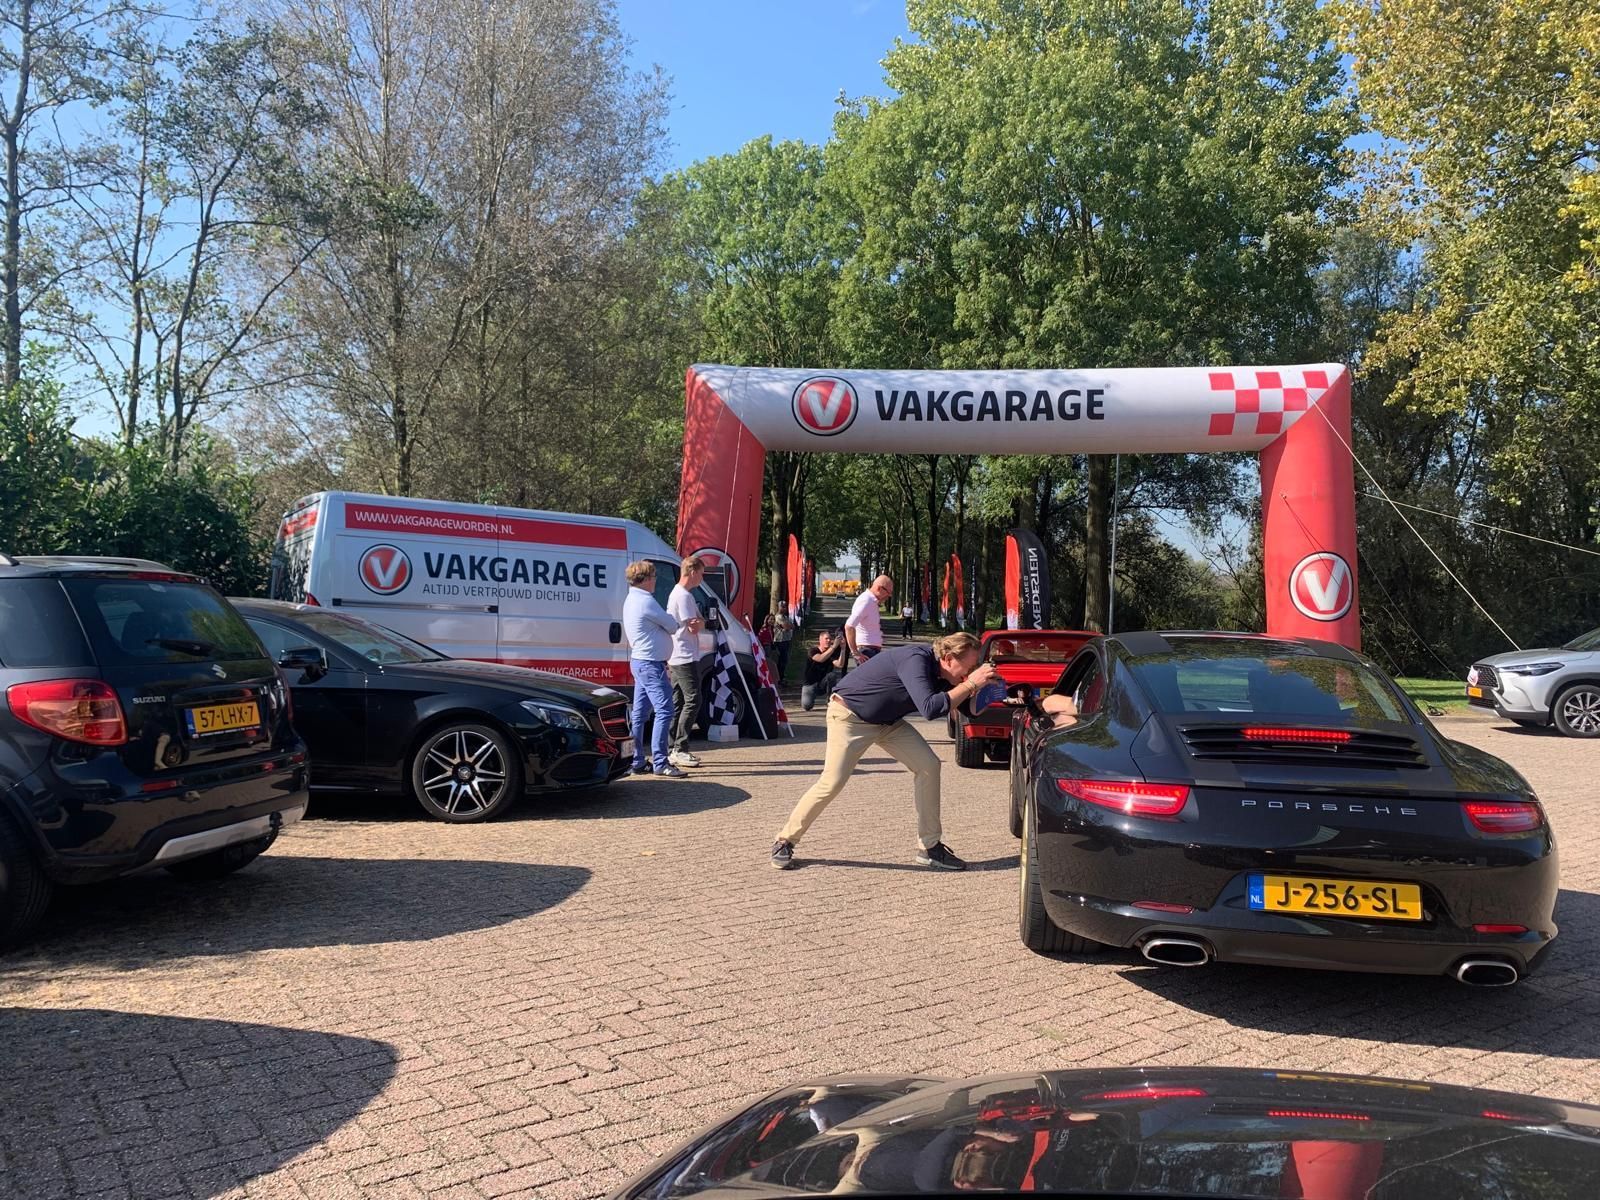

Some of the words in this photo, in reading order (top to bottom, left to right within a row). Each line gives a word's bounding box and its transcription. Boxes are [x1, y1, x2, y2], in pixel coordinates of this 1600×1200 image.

[807, 380, 847, 426] V
[875, 389, 1105, 421] VAKGARAGE
[355, 511, 515, 535] WWW.VAKGARAGEWORDEN.NL
[371, 549, 404, 587] V
[424, 552, 607, 589] VAKGARAGE
[422, 583, 459, 595] ALTIJD
[463, 586, 532, 600] VERTROUWD
[536, 590, 581, 602] DICHTBIJ
[1303, 560, 1345, 611] V
[132, 696, 165, 704] SUZUKI
[200, 705, 254, 728] 57-LHX-7
[1242, 800, 1417, 815] PORSCHE
[1251, 895, 1262, 904] NL
[1277, 881, 1408, 914] J-256-SL
